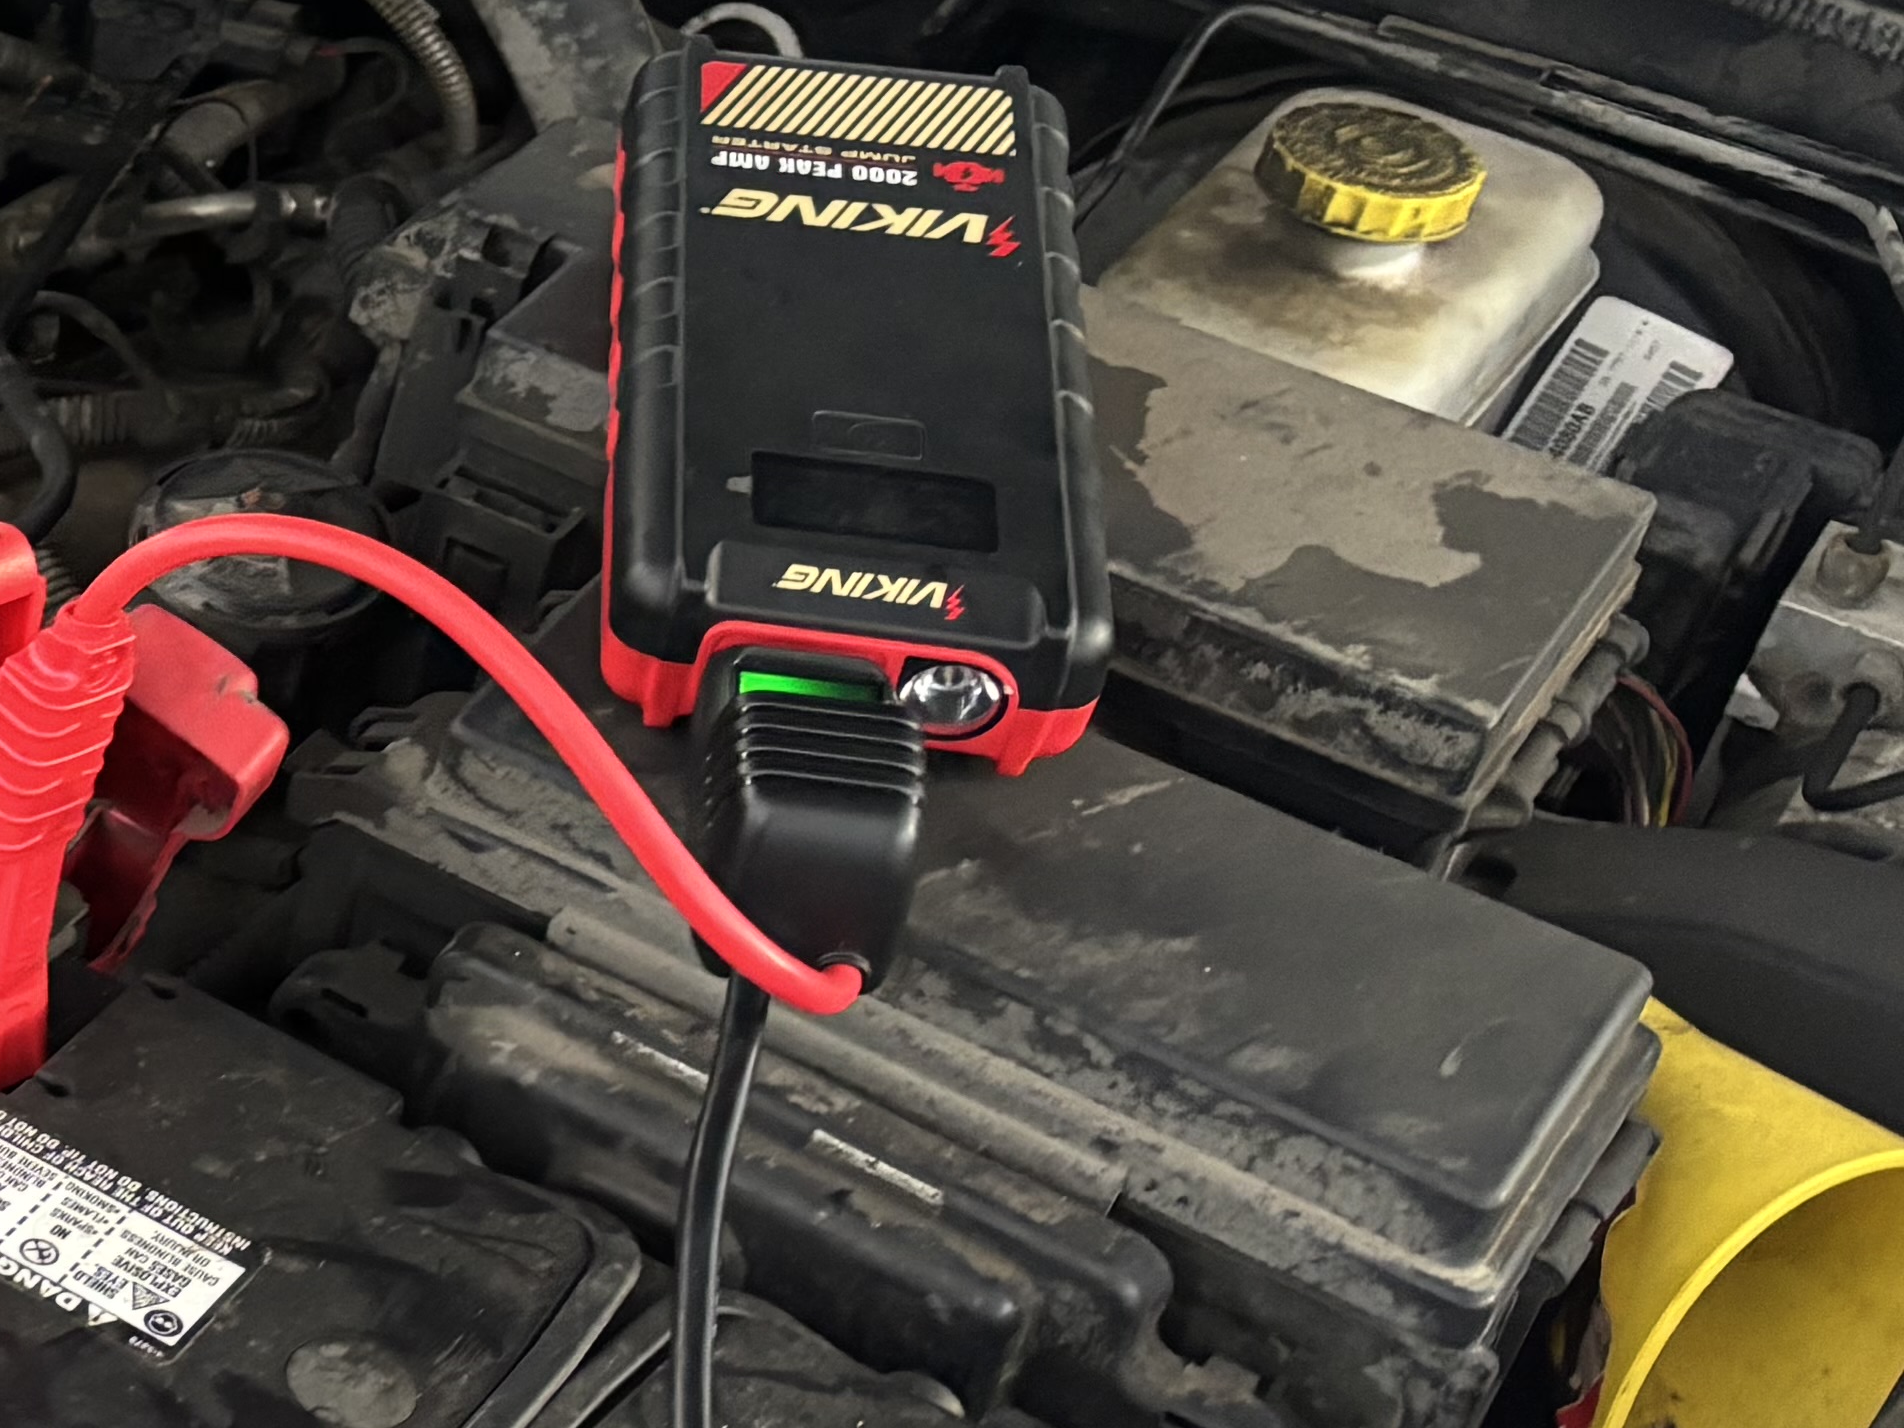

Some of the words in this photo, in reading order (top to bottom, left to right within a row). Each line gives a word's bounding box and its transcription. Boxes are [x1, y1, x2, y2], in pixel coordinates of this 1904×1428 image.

[711, 135, 832, 155] STARTER
[711, 150, 769, 170] AMP
[840, 150, 915, 163] JUMP
[778, 157, 842, 178] PEAK
[851, 164, 917, 185] 2000
[714, 189, 986, 242] VIKING
[778, 564, 946, 607] VIKING
[5, 1117, 37, 1137] NOT
[35, 1133, 60, 1149] DO
[42, 1147, 65, 1165] OF
[63, 1160, 113, 1190] REACH
[86, 1160, 118, 1180] NOT
[4, 1175, 28, 1192] CAN
[116, 1175, 141, 1192] DO
[112, 1185, 140, 1206] THE
[140, 1202, 163, 1218] OF
[49, 1224, 71, 1239] NO
[162, 1212, 195, 1234] OUT
[120, 1229, 181, 1266] BLINDNESS
[124, 1247, 149, 1263] CAN
[191, 1253, 211, 1267] OR
[93, 1263, 129, 1289] EYES.
[112, 1255, 181, 1297] EXPLOSIVE
[148, 1260, 191, 1288] GASES
[182, 1263, 219, 1286] CAUSE
[72, 1270, 118, 1299] SHIELD
